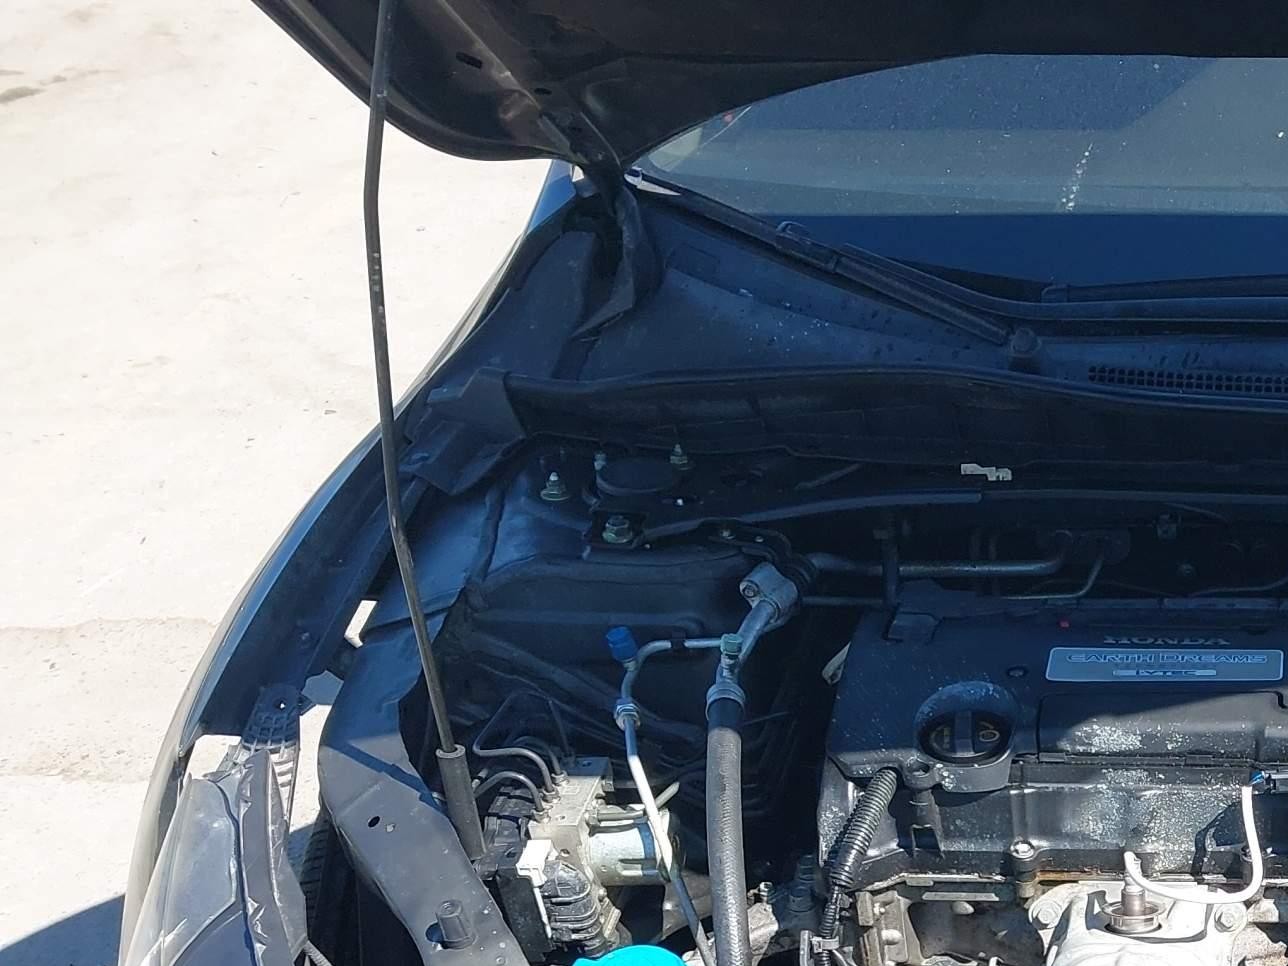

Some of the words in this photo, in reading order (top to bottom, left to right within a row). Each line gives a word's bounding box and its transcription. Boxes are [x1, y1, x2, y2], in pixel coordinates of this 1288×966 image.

[1103, 635, 1231, 646] HONDA
[1066, 652, 1154, 664] EARTH
[1159, 653, 1268, 664] DREAMS
